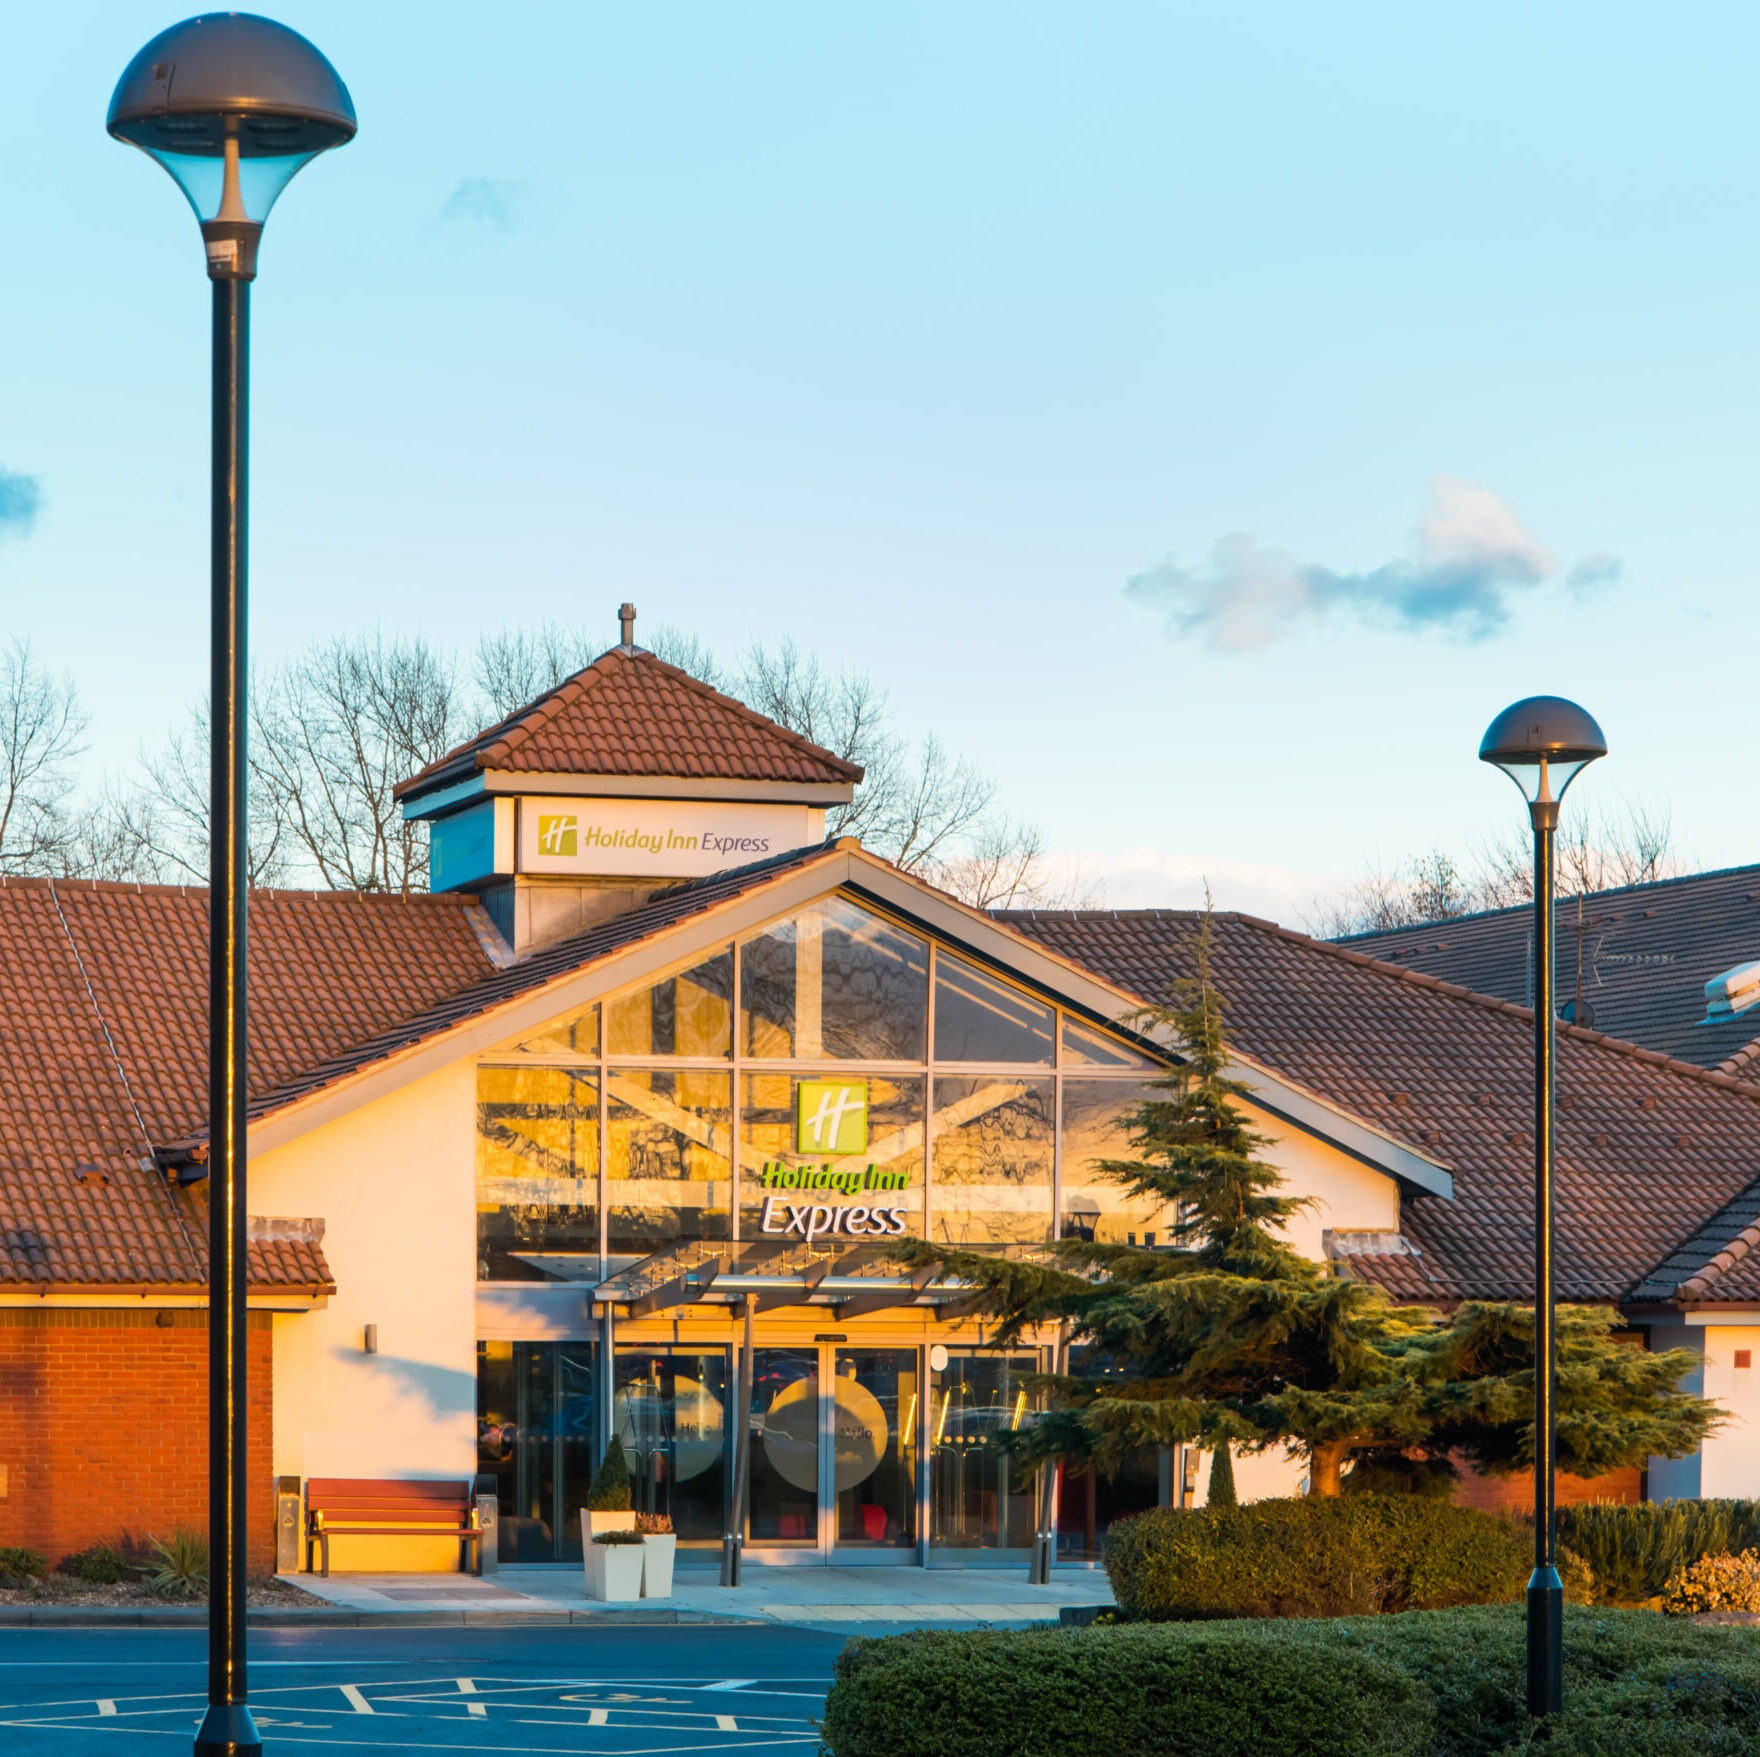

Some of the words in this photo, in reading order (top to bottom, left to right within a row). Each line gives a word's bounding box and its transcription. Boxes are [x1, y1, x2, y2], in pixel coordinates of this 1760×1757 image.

[585, 826, 663, 853] Holiday
[666, 828, 697, 849] Inn
[701, 832, 769, 855] Express
[761, 1161, 865, 1195] Holiday
[865, 1163, 909, 1190] Inn
[760, 1196, 907, 1242] Express
